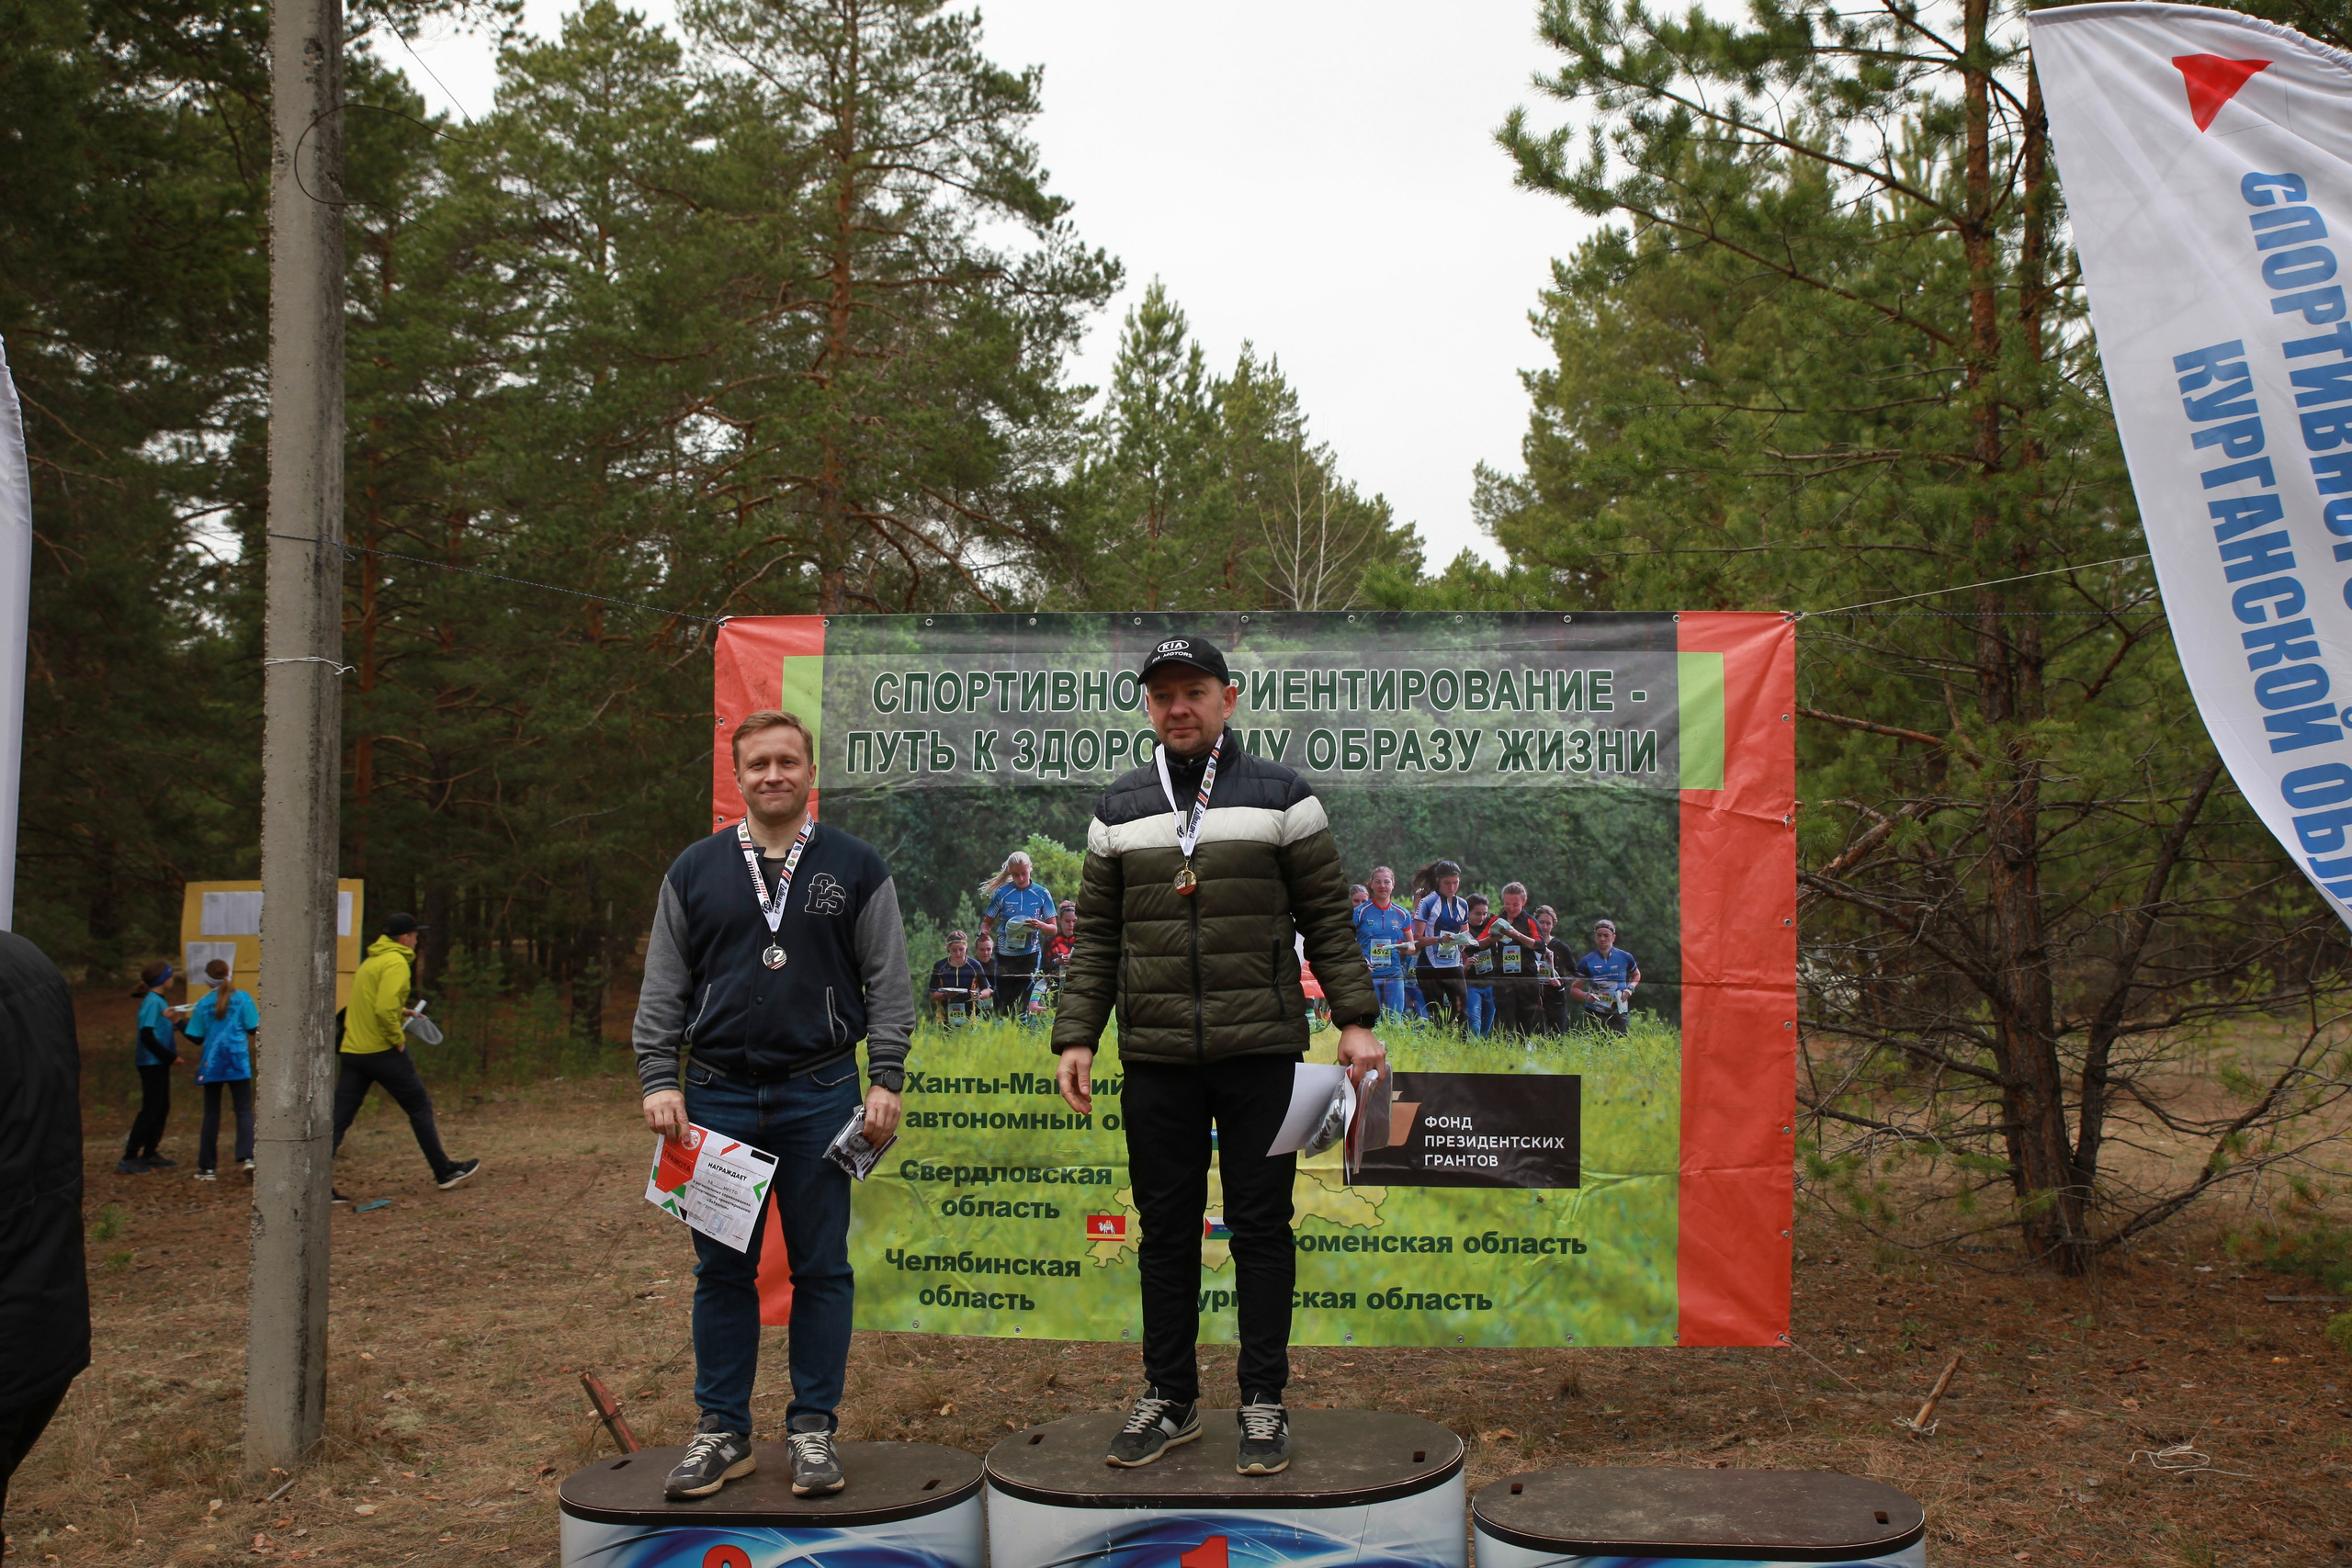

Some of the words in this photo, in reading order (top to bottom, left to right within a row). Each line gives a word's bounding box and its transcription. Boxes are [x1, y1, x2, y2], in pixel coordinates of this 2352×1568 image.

[2173, 339, 2352, 753] КУРГАНСКОЙ
[1161, 641, 1183, 651] KIA
[873, 670, 1148, 714] СПОРТИВНО
[1228, 667, 1614, 712] РИЕНТИРОВАНИЕ
[846, 728, 956, 773] ПУТЬ
[973, 729, 998, 773] К
[1012, 727, 1291, 779] ЗДОРОМУ
[1306, 728, 1482, 773] ОБРАЗУ
[1497, 728, 1657, 773] ЖИЗНИ
[905, 1111, 1092, 1131] автономный
[1424, 1115, 1473, 1131] ФОНД
[1424, 1135, 1565, 1150] ПРЕЗИДЕНТСКИХ
[664, 1150, 691, 1172] ГРАМОТА
[707, 1162, 747, 1181] НАГРАЖДАЕТ
[1424, 1154, 1499, 1168] ГРАНТОВ
[900, 1160, 1112, 1187] Свердловская
[941, 1195, 1060, 1219] область
[1293, 1235, 1453, 1253] юменская
[1463, 1230, 1588, 1255] область
[885, 1248, 1081, 1277] Челябинская
[919, 1284, 1035, 1311] область
[1366, 1287, 1493, 1311] область
